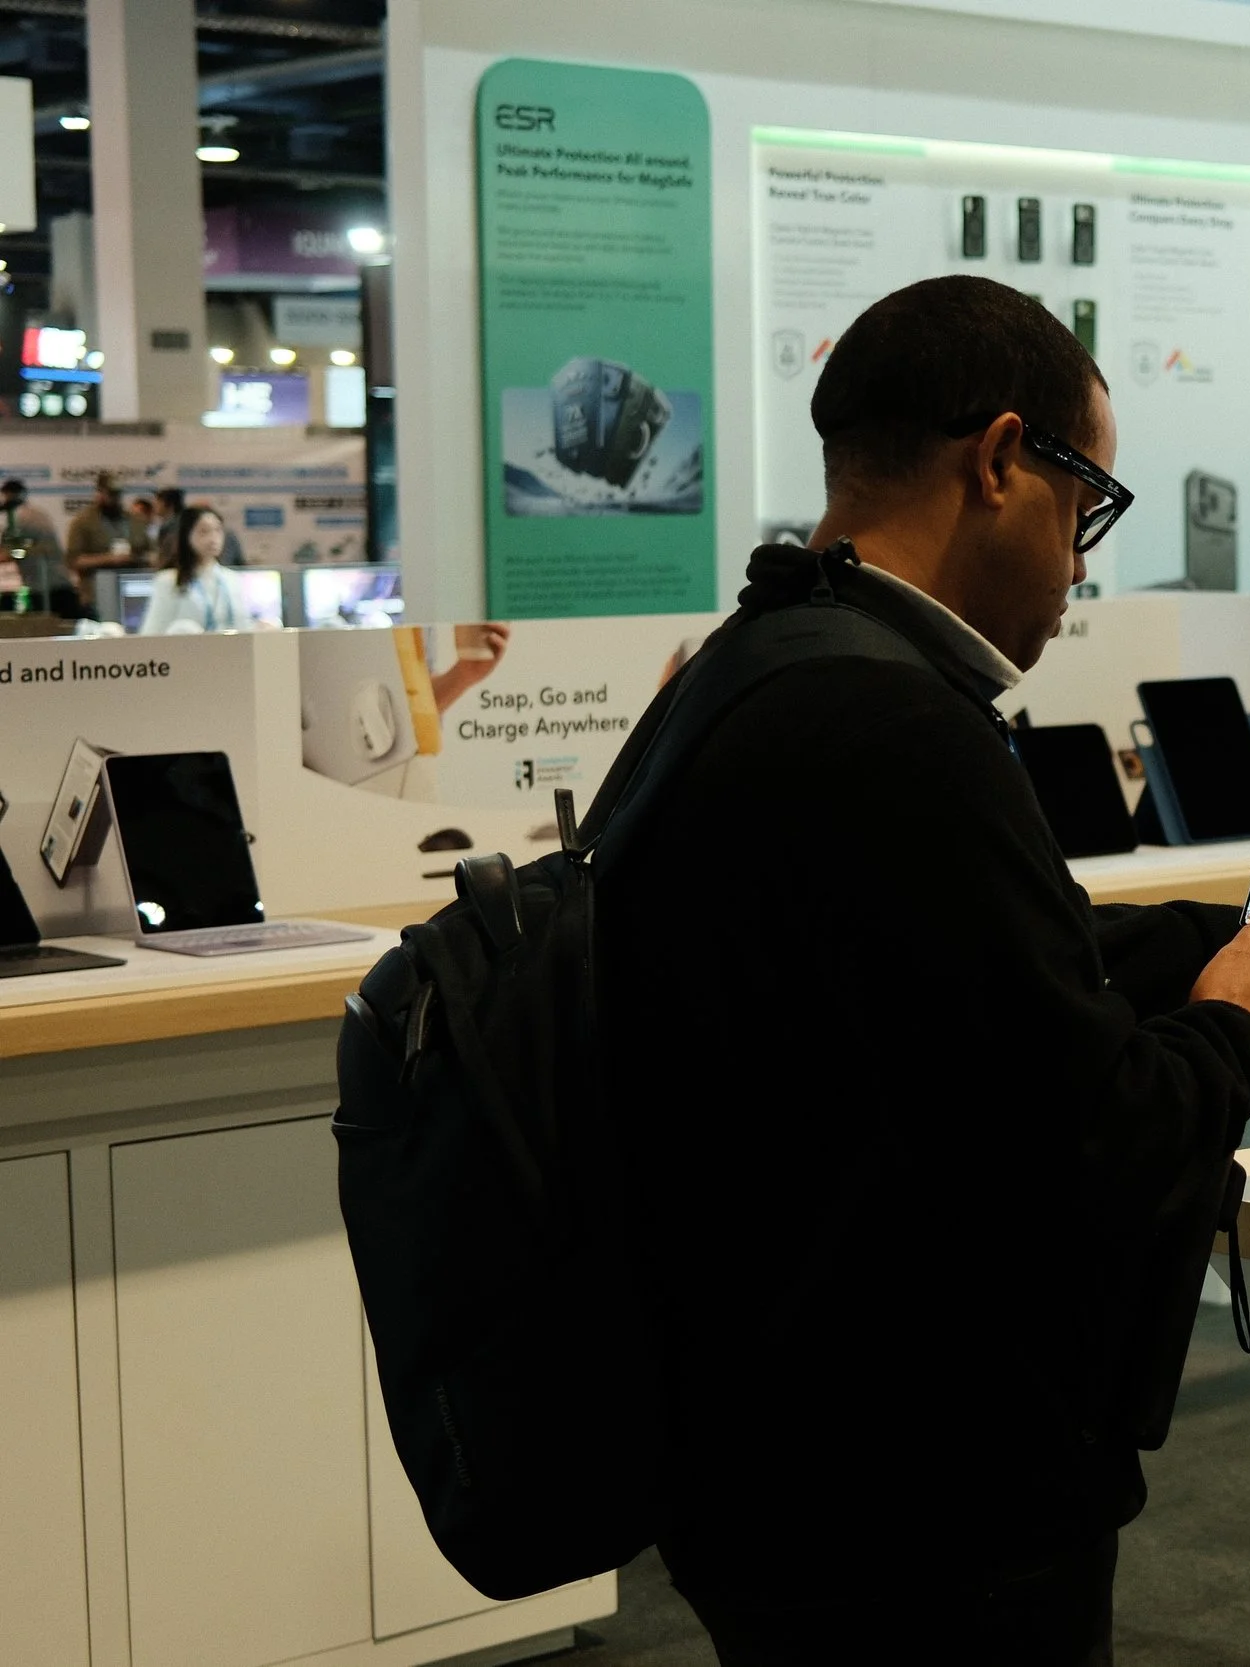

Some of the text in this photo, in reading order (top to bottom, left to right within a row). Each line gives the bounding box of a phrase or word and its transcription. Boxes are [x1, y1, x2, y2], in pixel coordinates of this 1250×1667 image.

[496, 103, 556, 131] ESR
[497, 144, 552, 158] Ultimate
[556, 148, 621, 163] Protection
[498, 164, 528, 177] Peak
[533, 166, 613, 182] Performance
[618, 171, 636, 183] for
[1069, 621, 1089, 637] All
[21, 660, 64, 682] and
[72, 660, 170, 681] Innovate
[481, 683, 607, 713] Snap, Go and
[459, 713, 630, 742] Charge Anywhere
